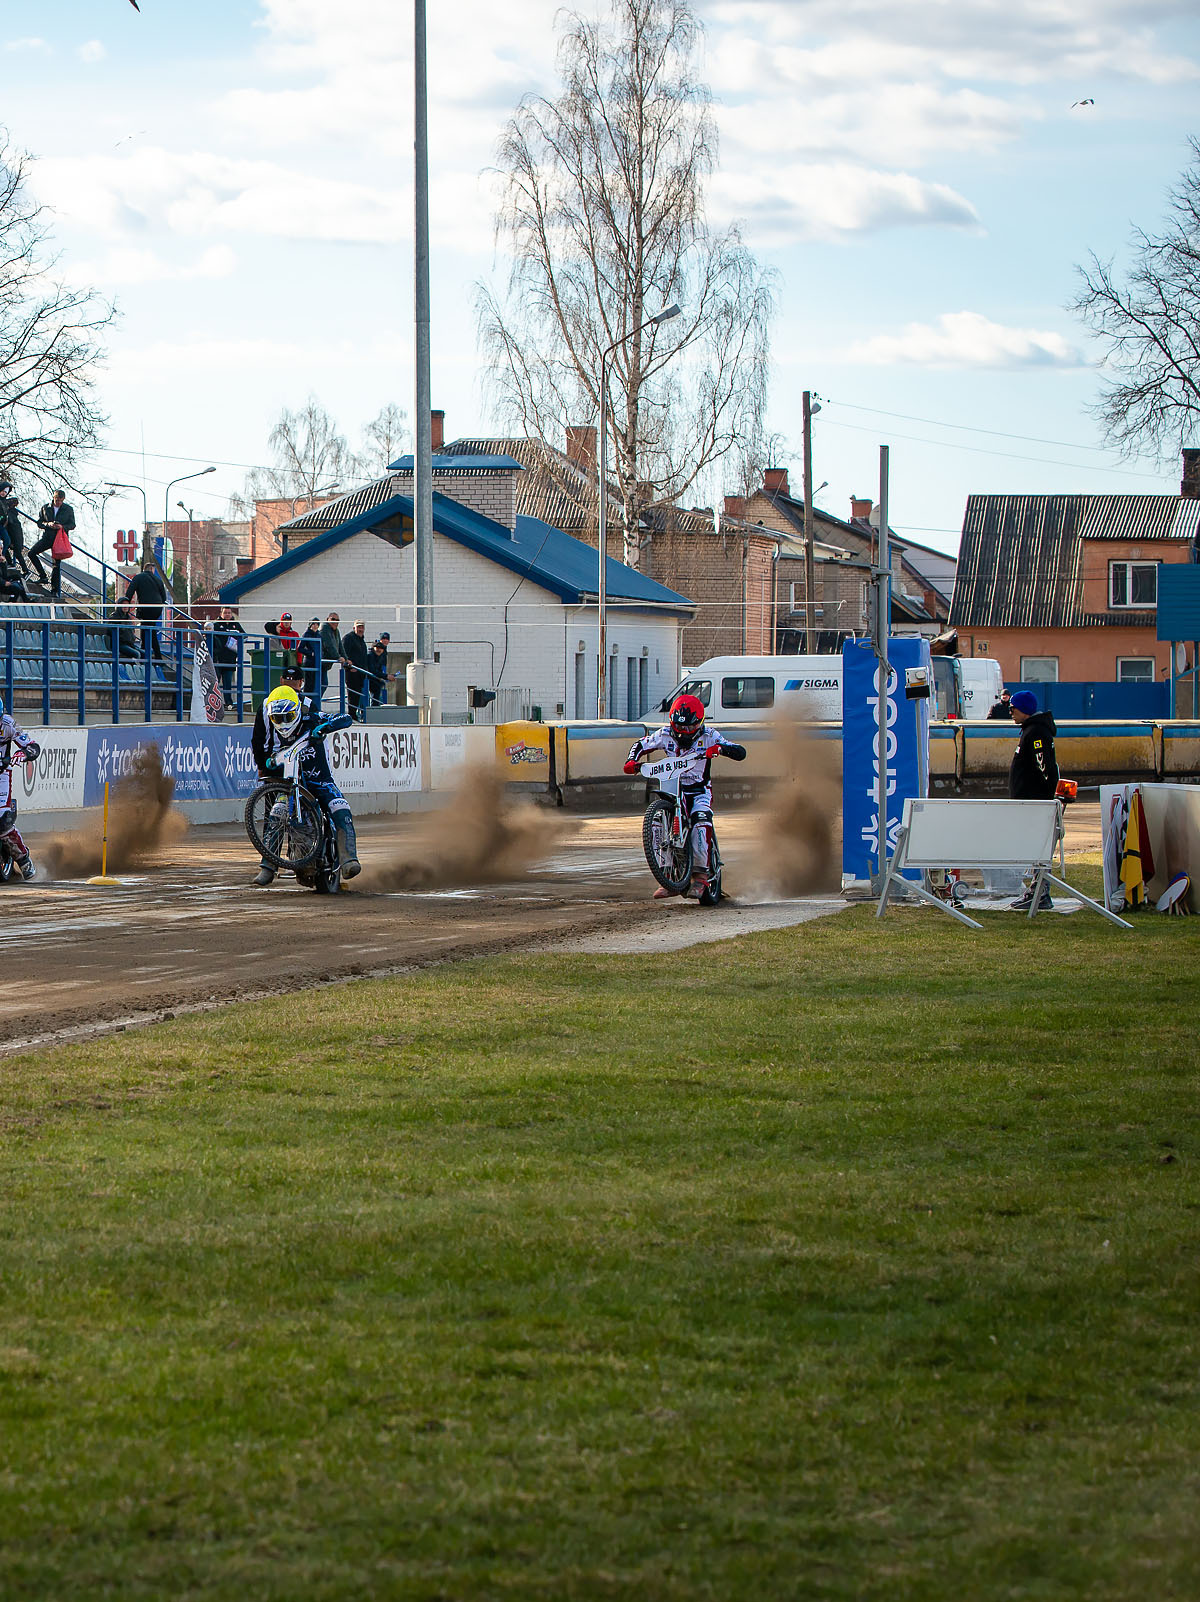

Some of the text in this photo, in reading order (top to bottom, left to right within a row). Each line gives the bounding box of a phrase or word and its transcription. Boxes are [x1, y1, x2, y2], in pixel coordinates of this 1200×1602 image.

[804, 679, 839, 687] SIGMA
[38, 747, 78, 780] OPTIBET
[175, 740, 211, 773] trodo
[235, 741, 258, 772] tro
[332, 732, 417, 769] SOFIA SOFIA
[649, 764, 664, 776] JBM
